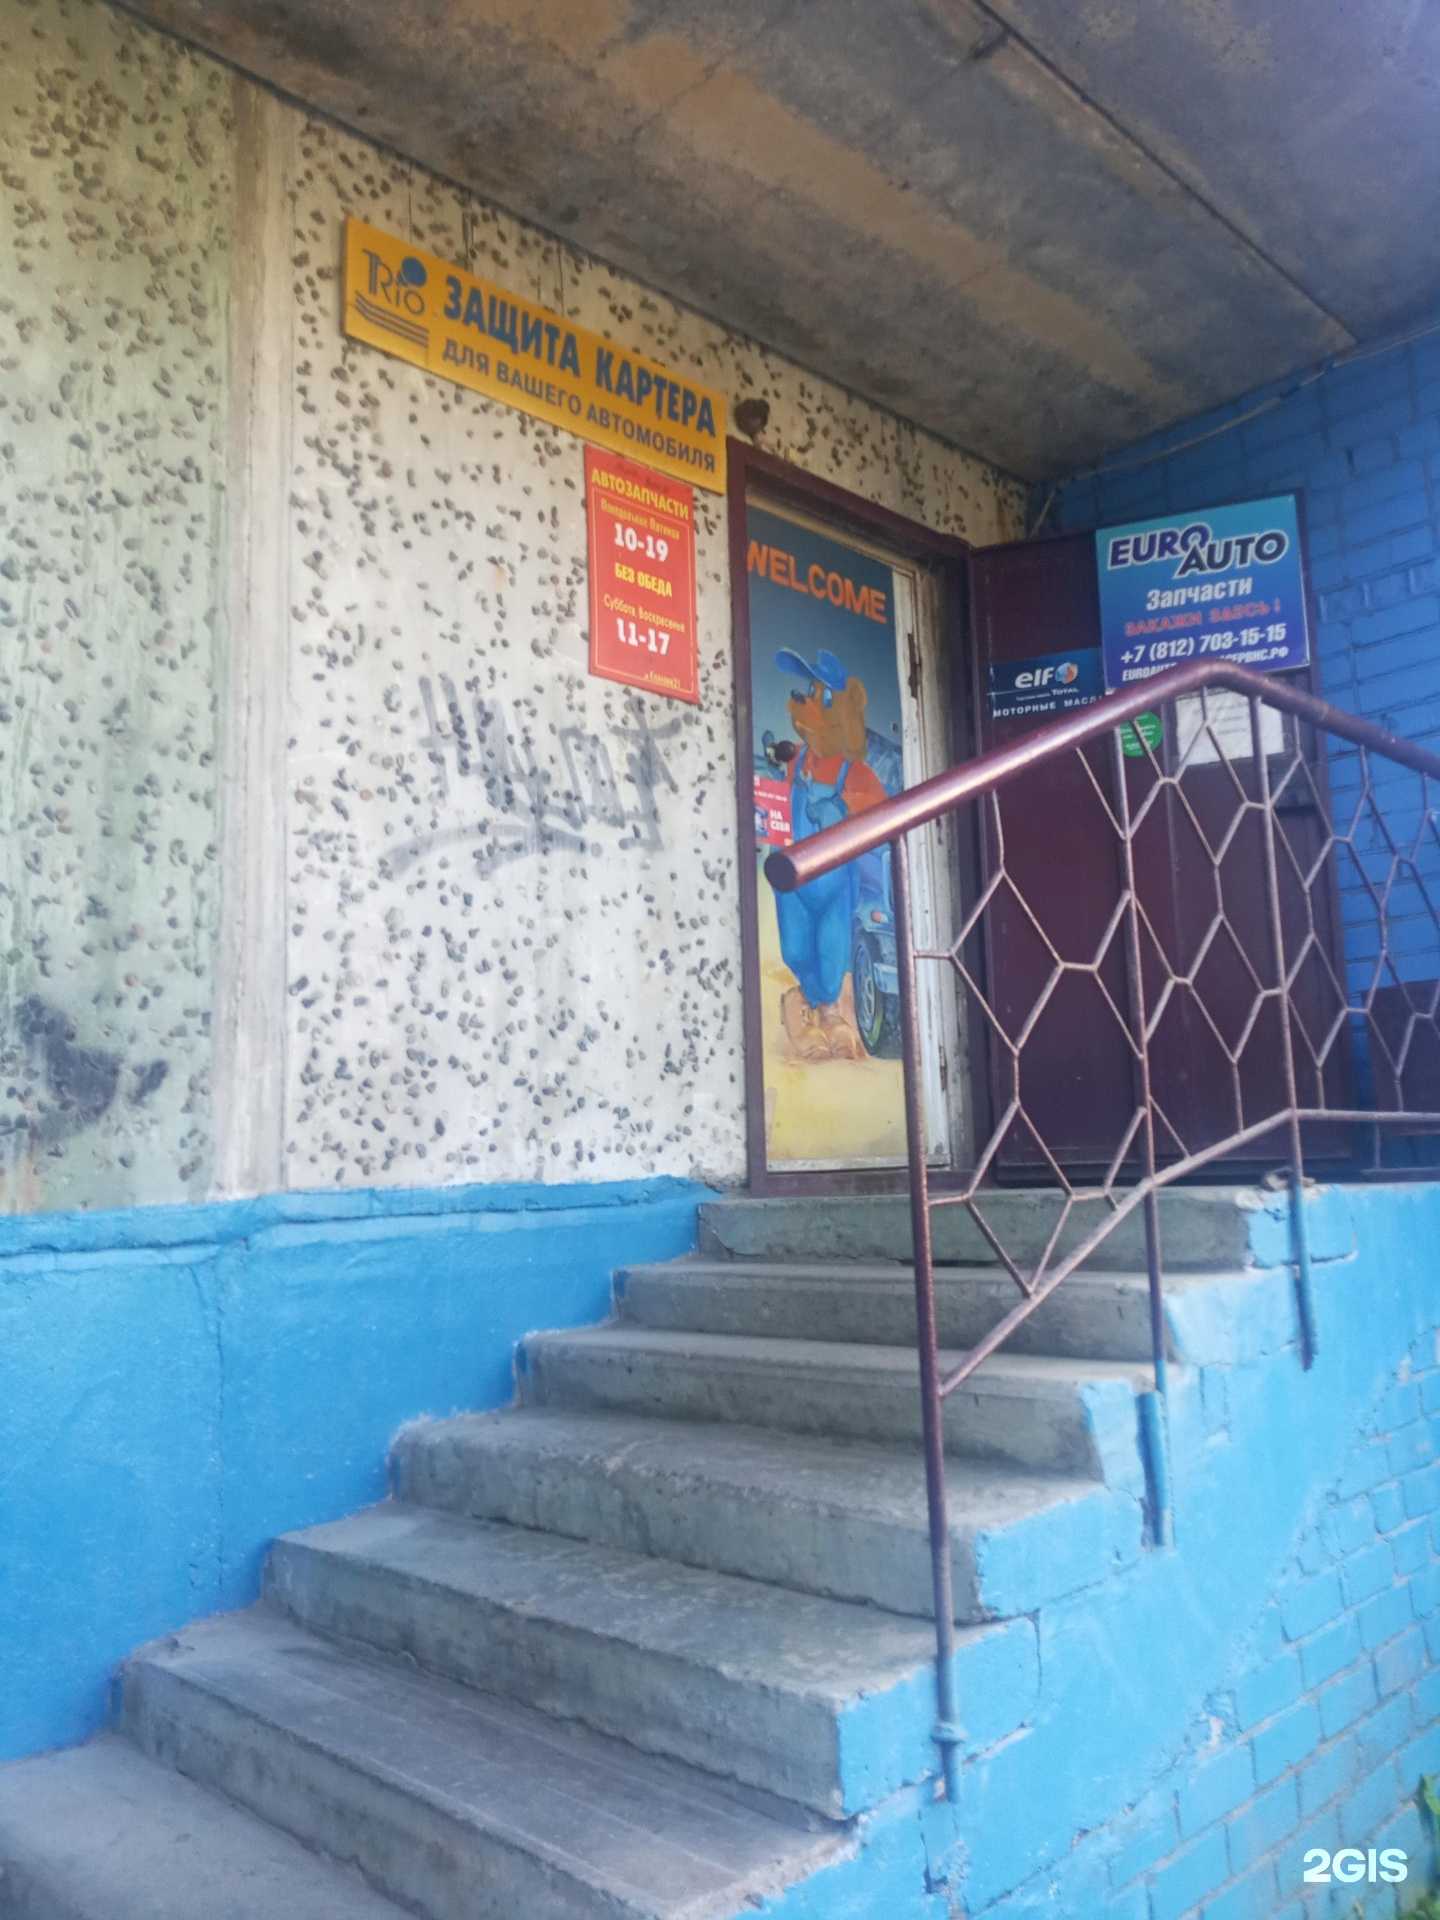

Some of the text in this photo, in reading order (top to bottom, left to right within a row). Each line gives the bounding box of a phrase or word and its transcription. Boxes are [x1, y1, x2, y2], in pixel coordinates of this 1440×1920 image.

[442, 274, 717, 439] ЗАЩИТА КАРТЕРА
[442, 337, 717, 474] ДЛЯ ВАШЕГО АВТОМОБИЛЯ
[591, 467, 689, 521] АВТОЗАПЧАСТИ
[614, 522, 669, 562] 10-19
[615, 562, 673, 598] БЕЗ ОБЕДА
[746, 540, 887, 624] WELCOME
[1146, 577, 1254, 611] Запчасти
[616, 617, 671, 656] 11-17
[1121, 623, 1287, 664] +7 (812) 703-15-15
[1014, 666, 1056, 689] elf
[993, 702, 1057, 718] МОТОРНЫЕ
[1064, 696, 1103, 708] МАСЛ
